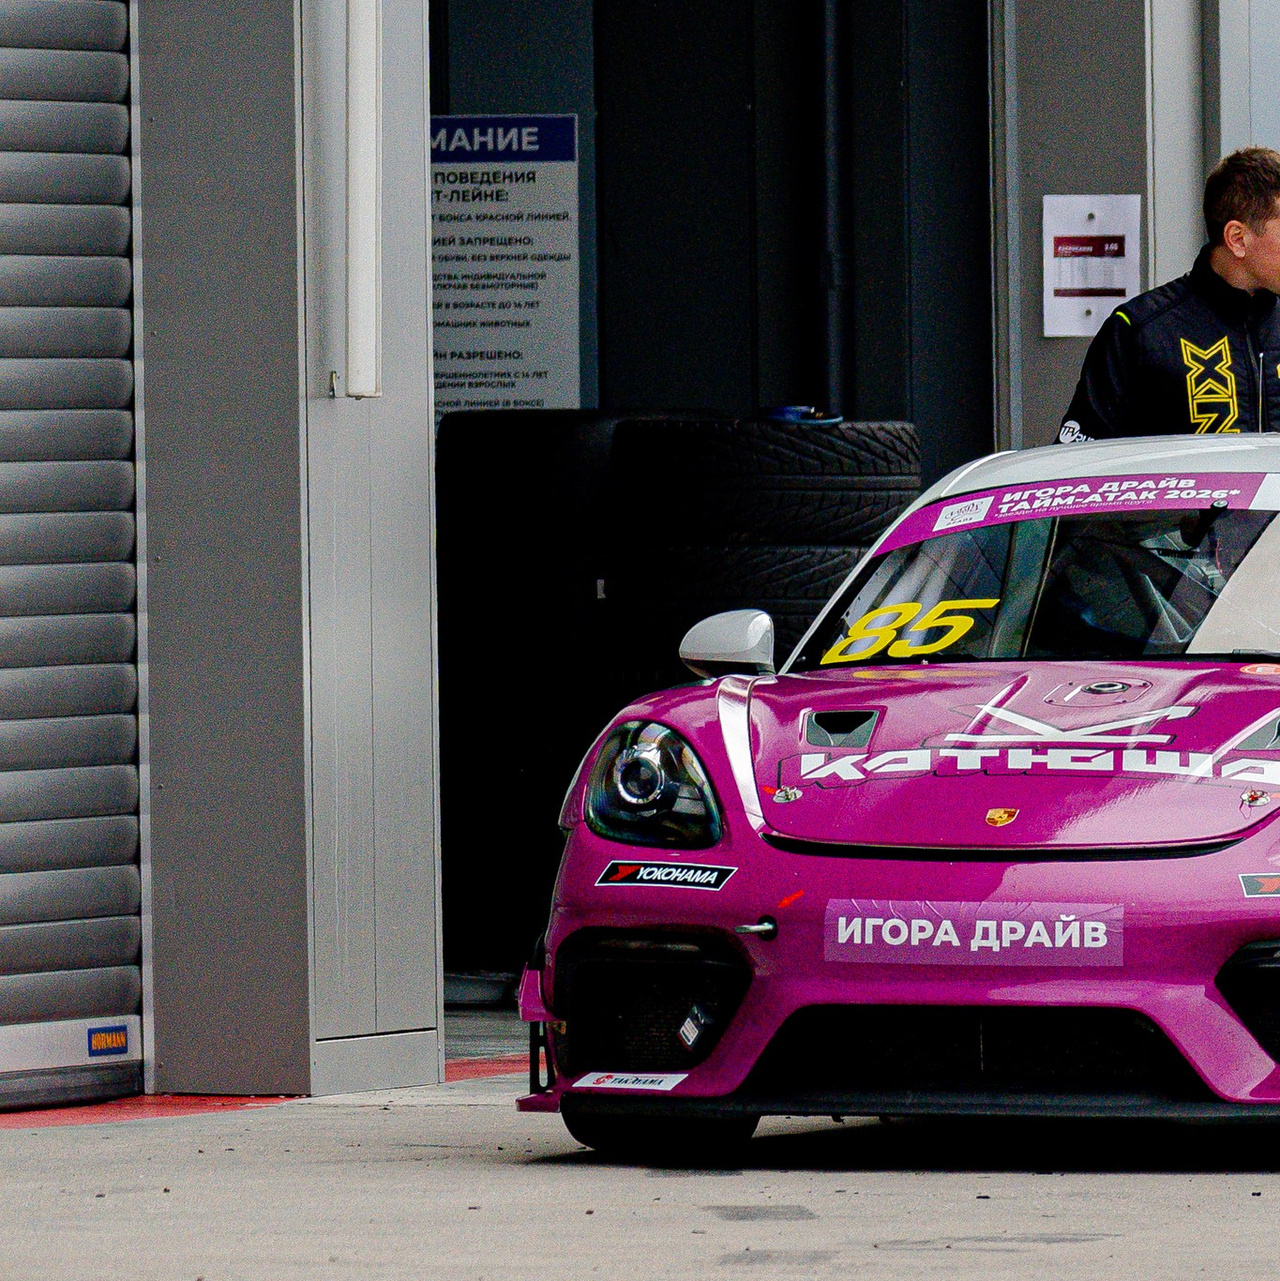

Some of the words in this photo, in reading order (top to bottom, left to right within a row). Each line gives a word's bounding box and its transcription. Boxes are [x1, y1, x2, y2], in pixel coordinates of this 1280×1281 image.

[434, 171, 537, 185] ПОВЕДЕНИЯ
[431, 188, 509, 202] Т-ЛЕЙНЕ:
[1002, 484, 1091, 503] ИГОРА
[1098, 477, 1196, 493] ДРАЙВ
[998, 491, 1162, 514] ТАЙМ-АТАК
[820, 599, 1001, 665] 85
[636, 866, 718, 885] YOKOHAMA
[838, 916, 961, 946] ИГОРА
[970, 914, 1108, 952] ДРАЙВ
